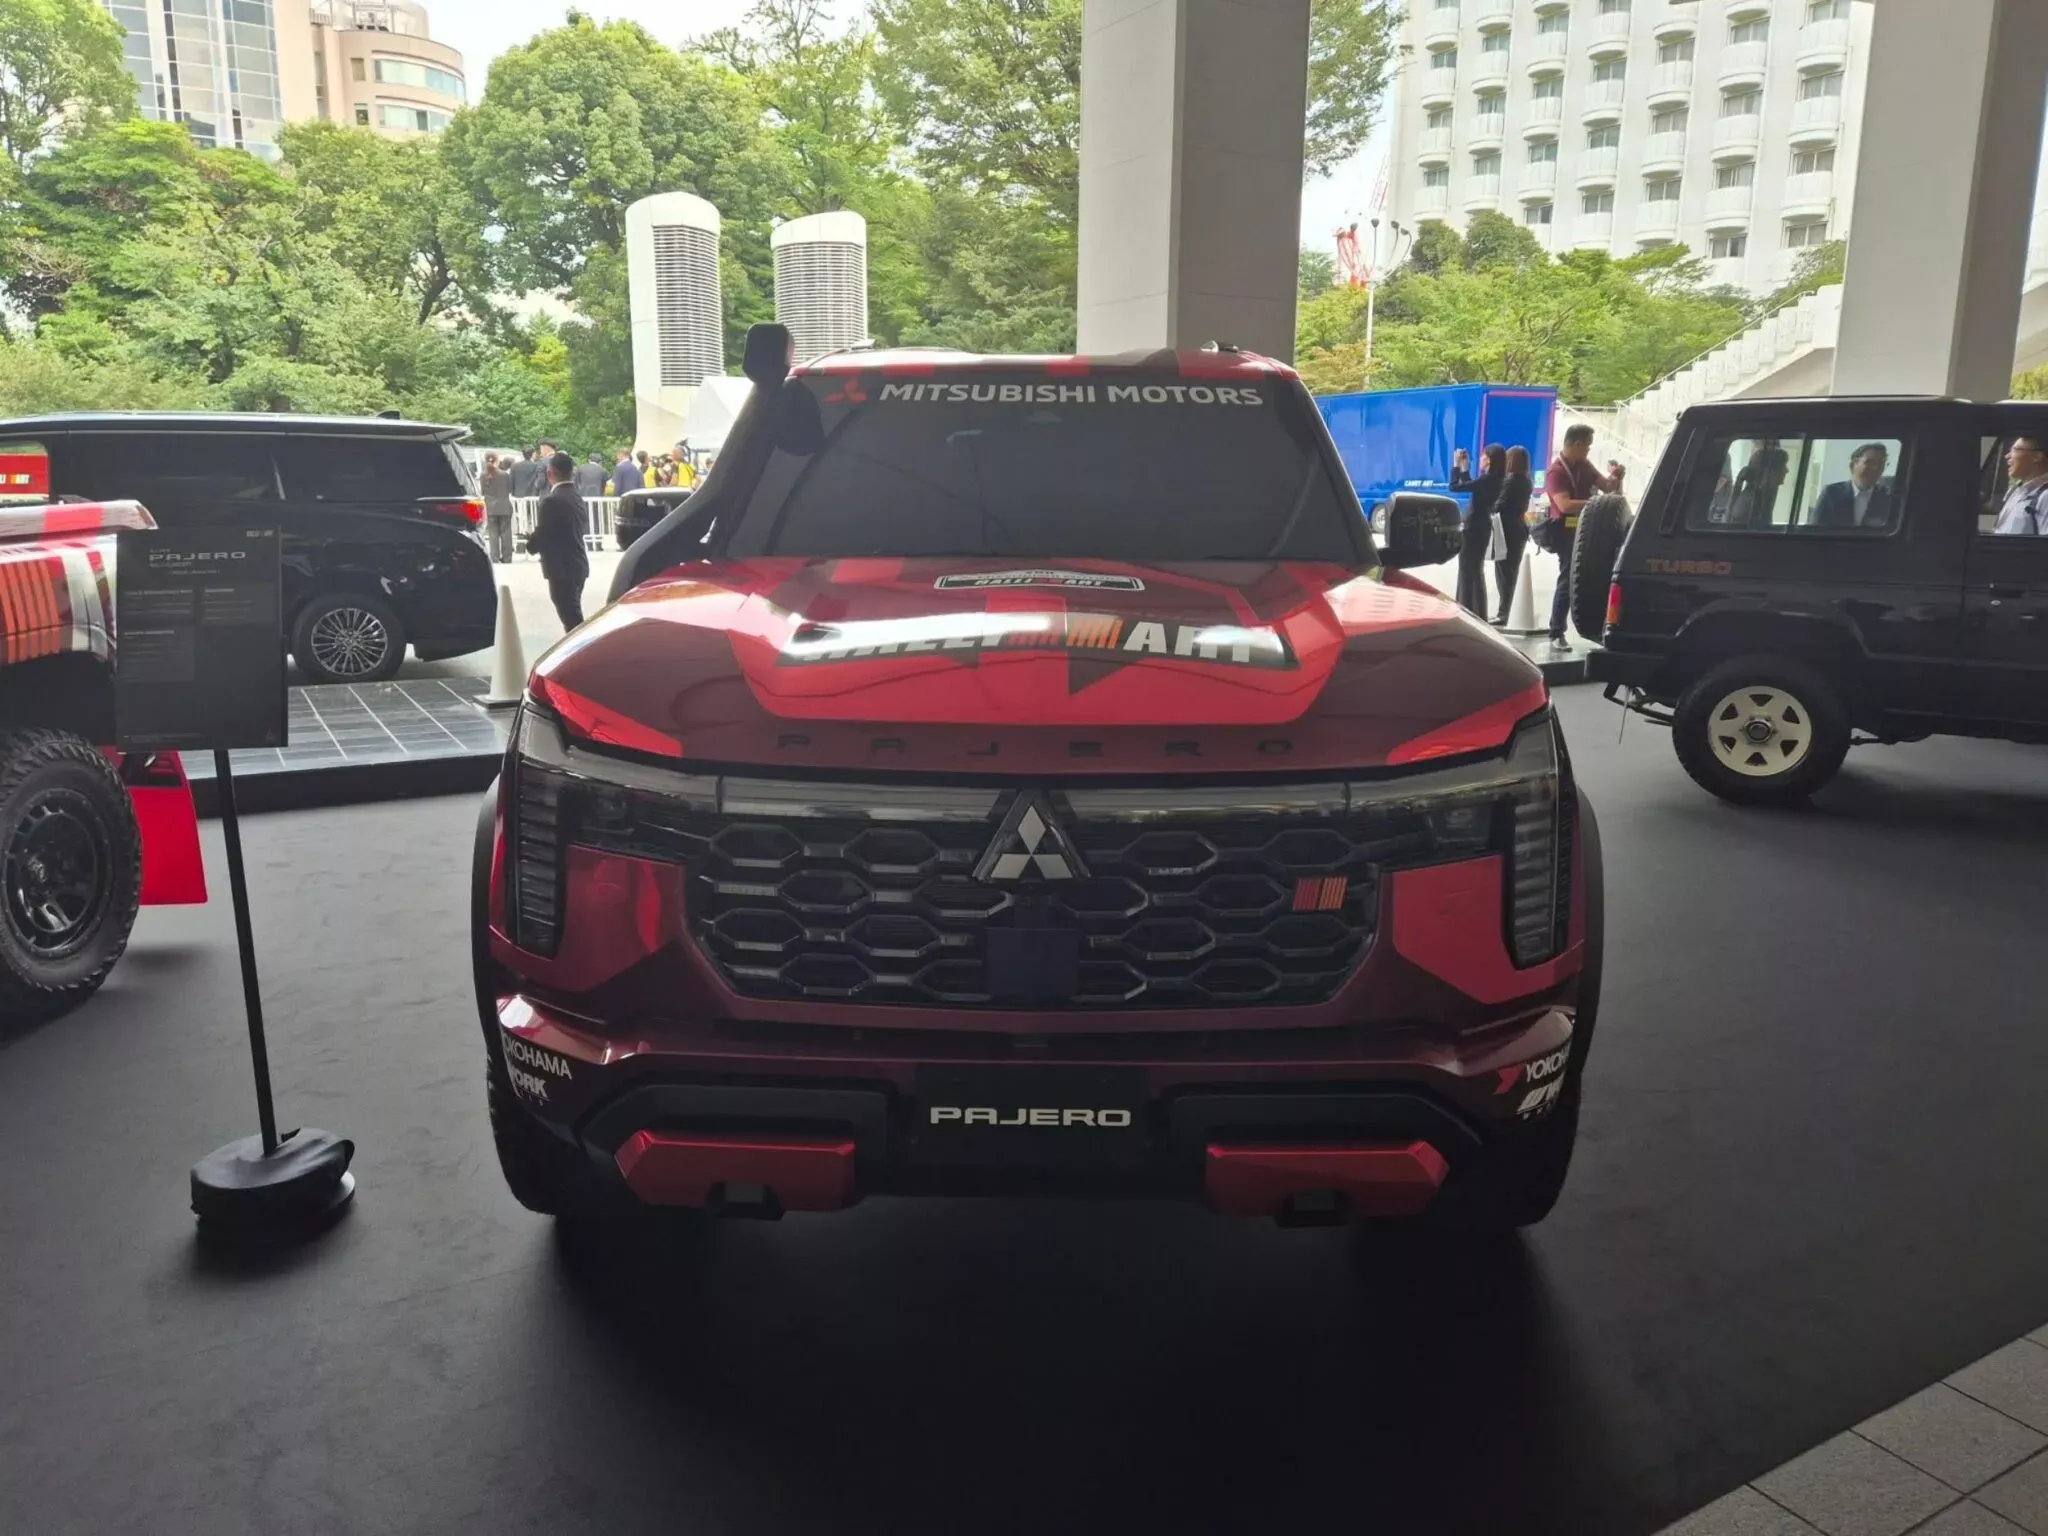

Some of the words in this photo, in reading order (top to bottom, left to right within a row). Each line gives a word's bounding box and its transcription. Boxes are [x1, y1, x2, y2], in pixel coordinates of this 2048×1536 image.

[879, 383, 1096, 402] MITSUBISHI
[1107, 385, 1263, 405] MOTORS
[149, 551, 247, 561] PAJERO
[1645, 558, 1732, 575] TURBO
[777, 733, 1293, 757] PAJERO
[501, 1032, 572, 1080] OKOHAMA
[930, 1107, 1132, 1127] PAJERO
